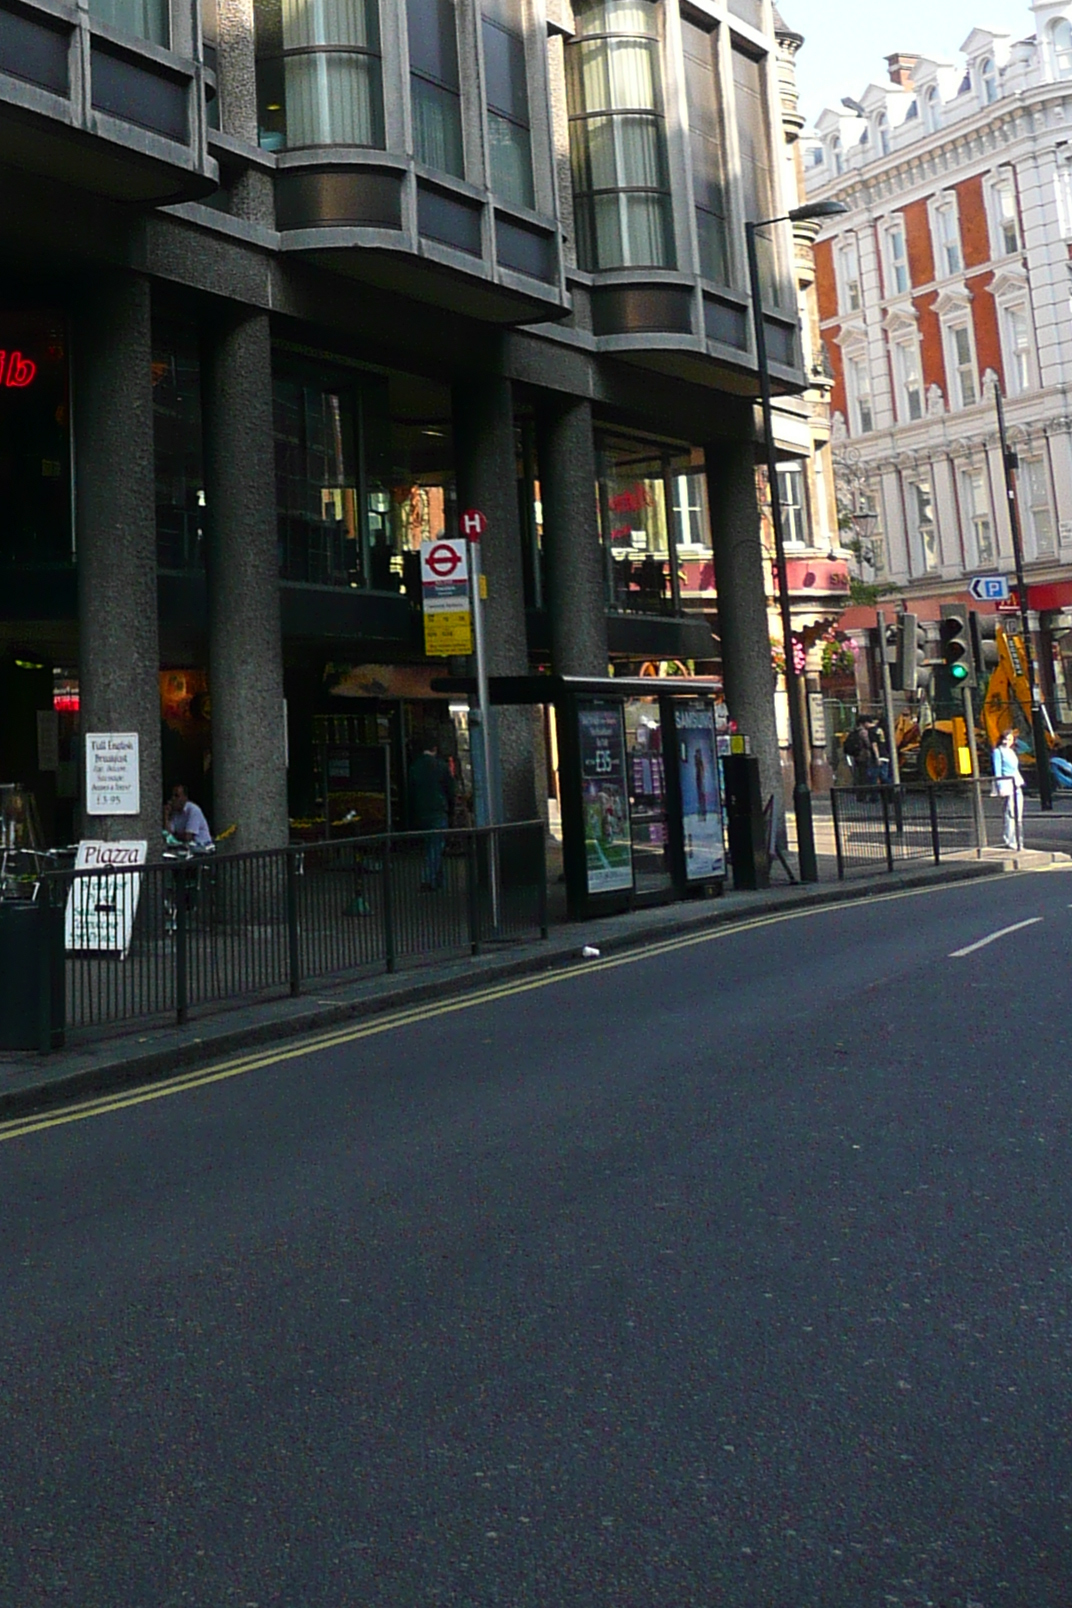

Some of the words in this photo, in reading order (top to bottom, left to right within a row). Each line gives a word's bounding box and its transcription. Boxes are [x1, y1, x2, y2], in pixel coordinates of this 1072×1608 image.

[464, 513, 481, 533] H
[988, 582, 1000, 596] P
[84, 845, 140, 865] Piazza
